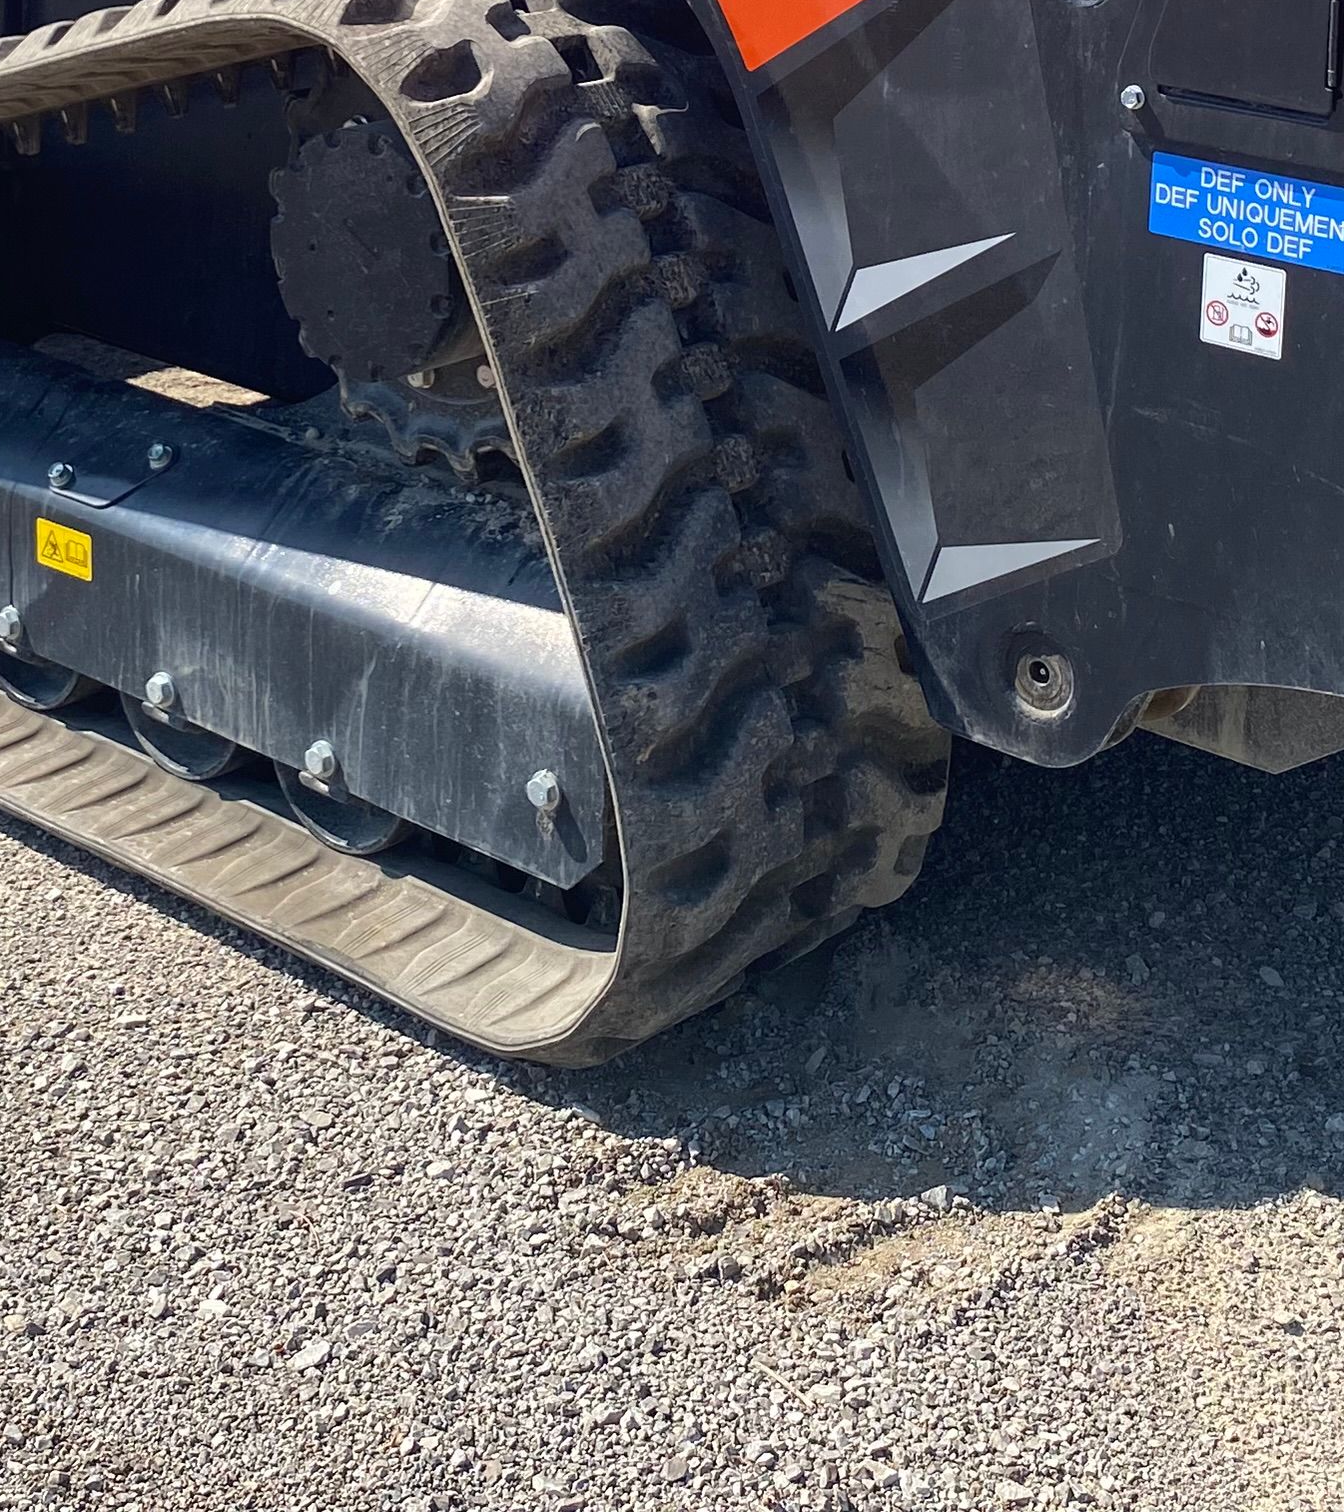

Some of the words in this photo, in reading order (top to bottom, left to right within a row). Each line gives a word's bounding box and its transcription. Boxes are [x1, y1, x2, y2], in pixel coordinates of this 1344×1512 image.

[1155, 182, 1200, 210] DEF
[1200, 166, 1246, 194] DEF
[1254, 178, 1316, 209] ONLY
[1198, 217, 1259, 249] SOLO
[1266, 234, 1314, 260] DEF
